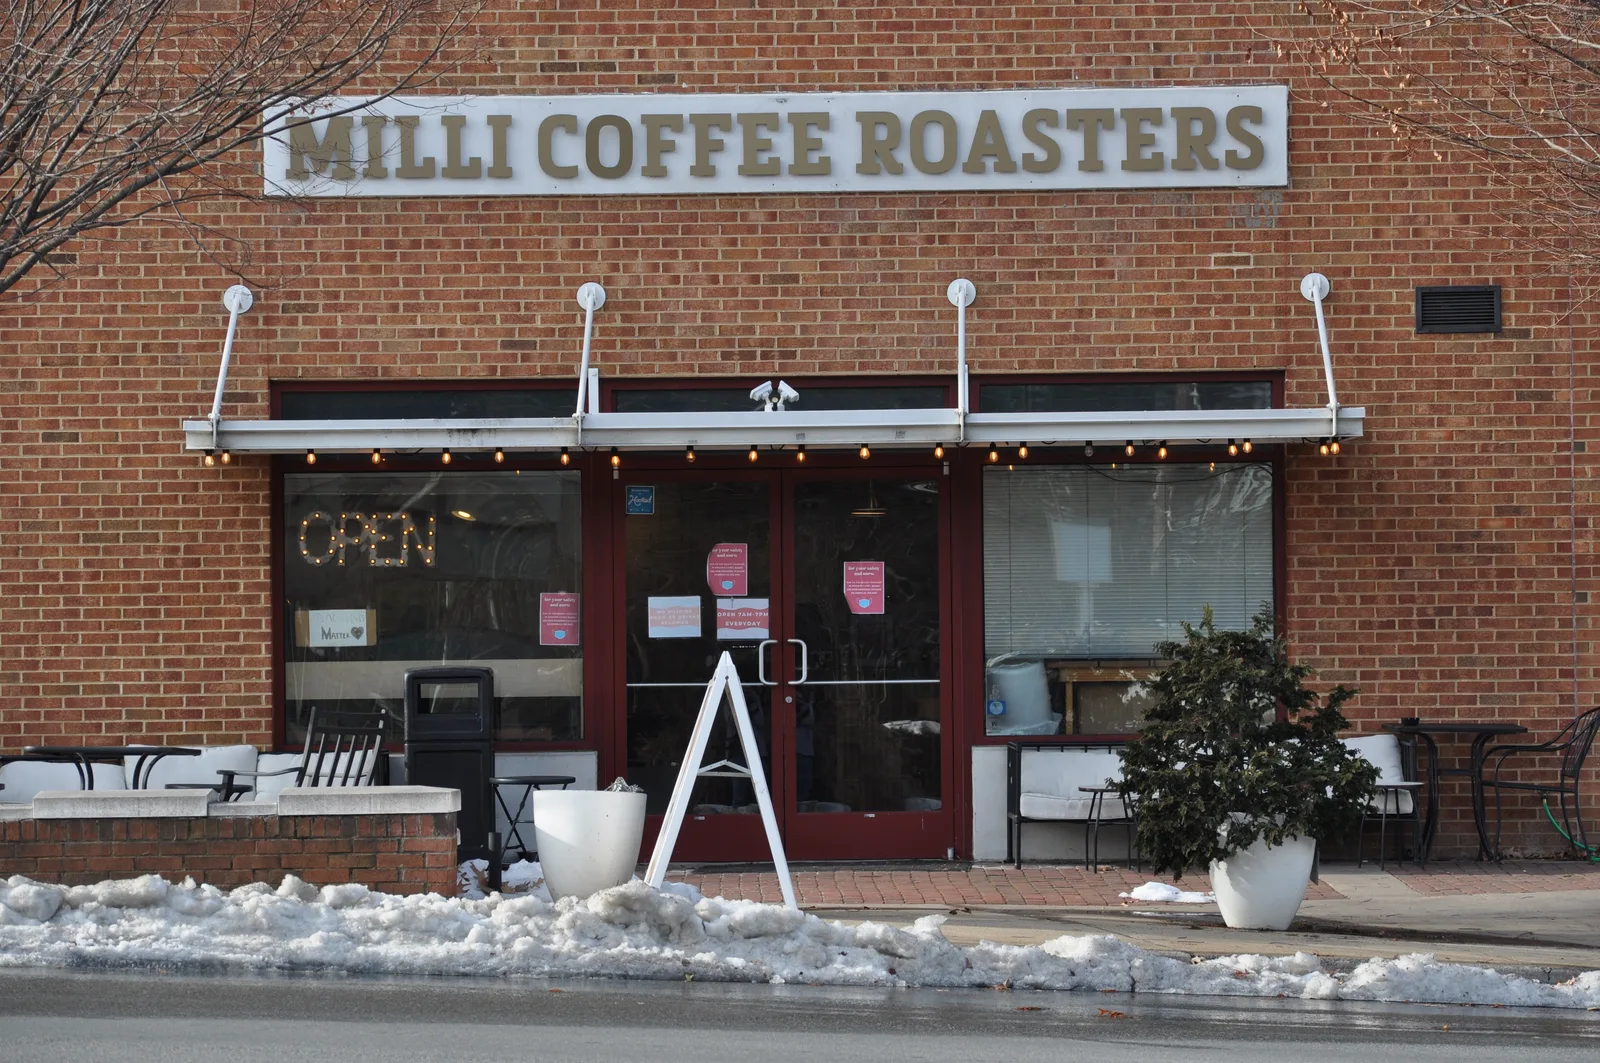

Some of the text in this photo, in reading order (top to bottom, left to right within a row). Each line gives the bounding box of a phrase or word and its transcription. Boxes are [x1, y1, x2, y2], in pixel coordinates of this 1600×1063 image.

[285, 105, 1265, 180] MILLI COFFEE ROASTERS
[299, 511, 437, 568] OPEN
